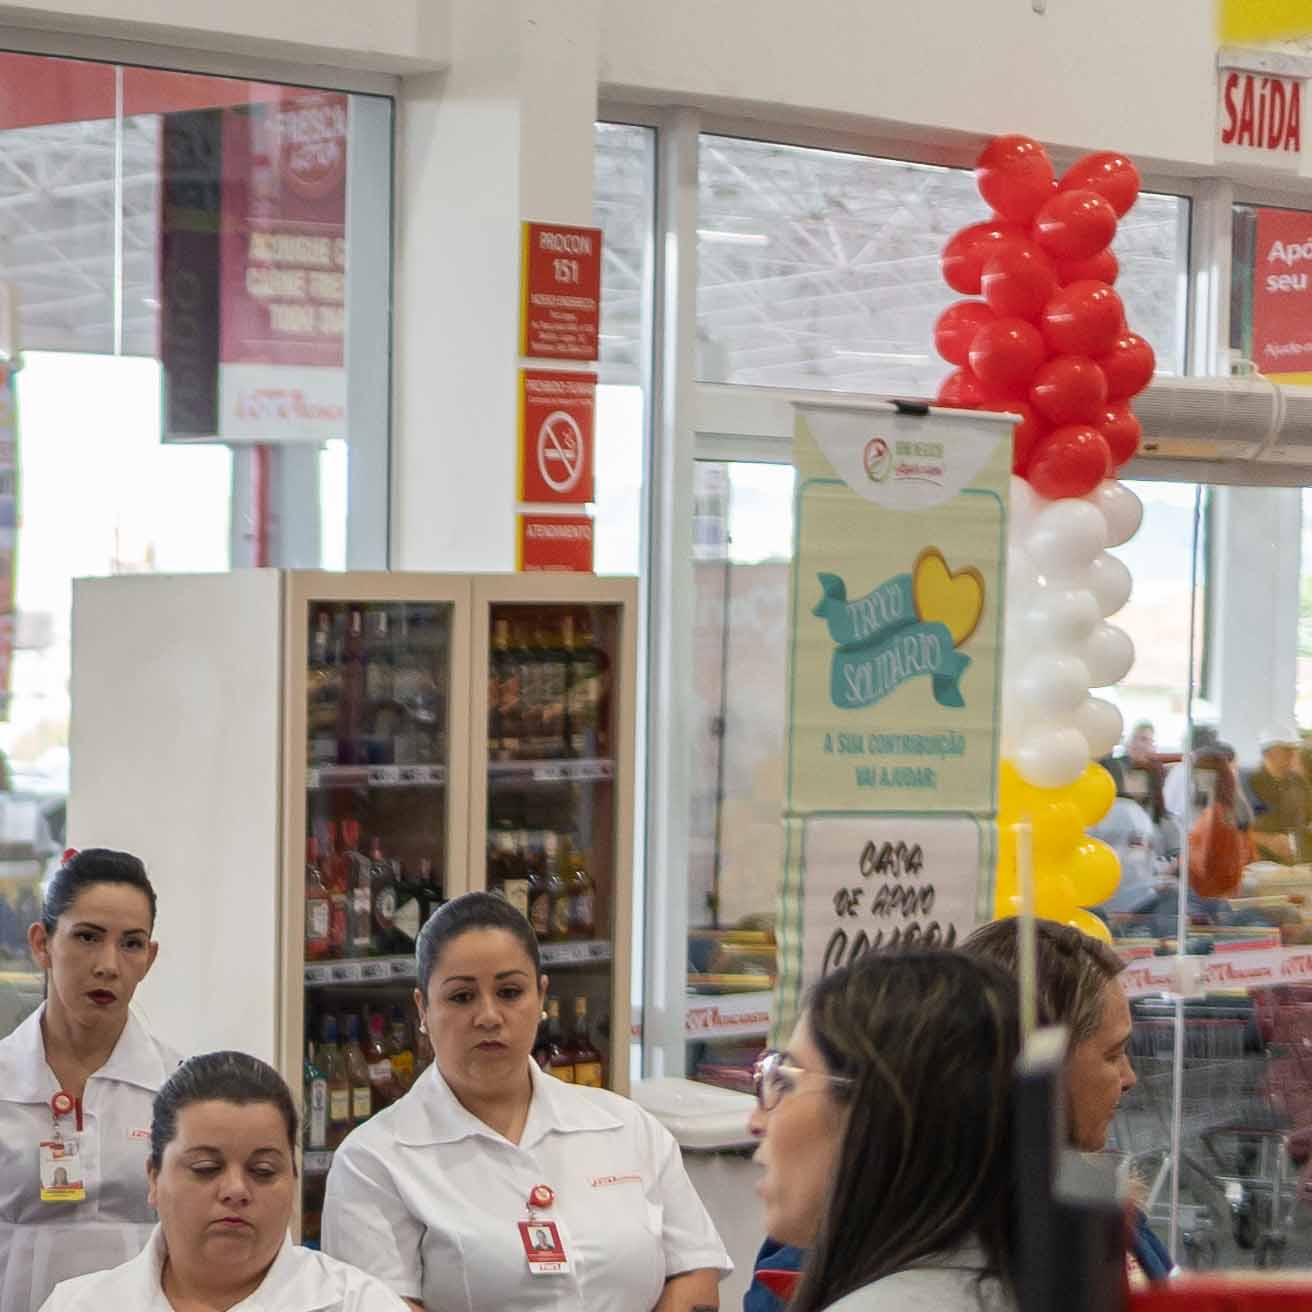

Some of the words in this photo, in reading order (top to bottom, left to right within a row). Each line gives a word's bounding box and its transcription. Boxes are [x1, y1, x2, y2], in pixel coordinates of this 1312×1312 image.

[552, 258, 579, 284] 151
[1265, 273, 1307, 292] seu
[860, 840, 924, 878] CASA
[833, 886, 863, 917] DE
[872, 883, 935, 918] APOIO
